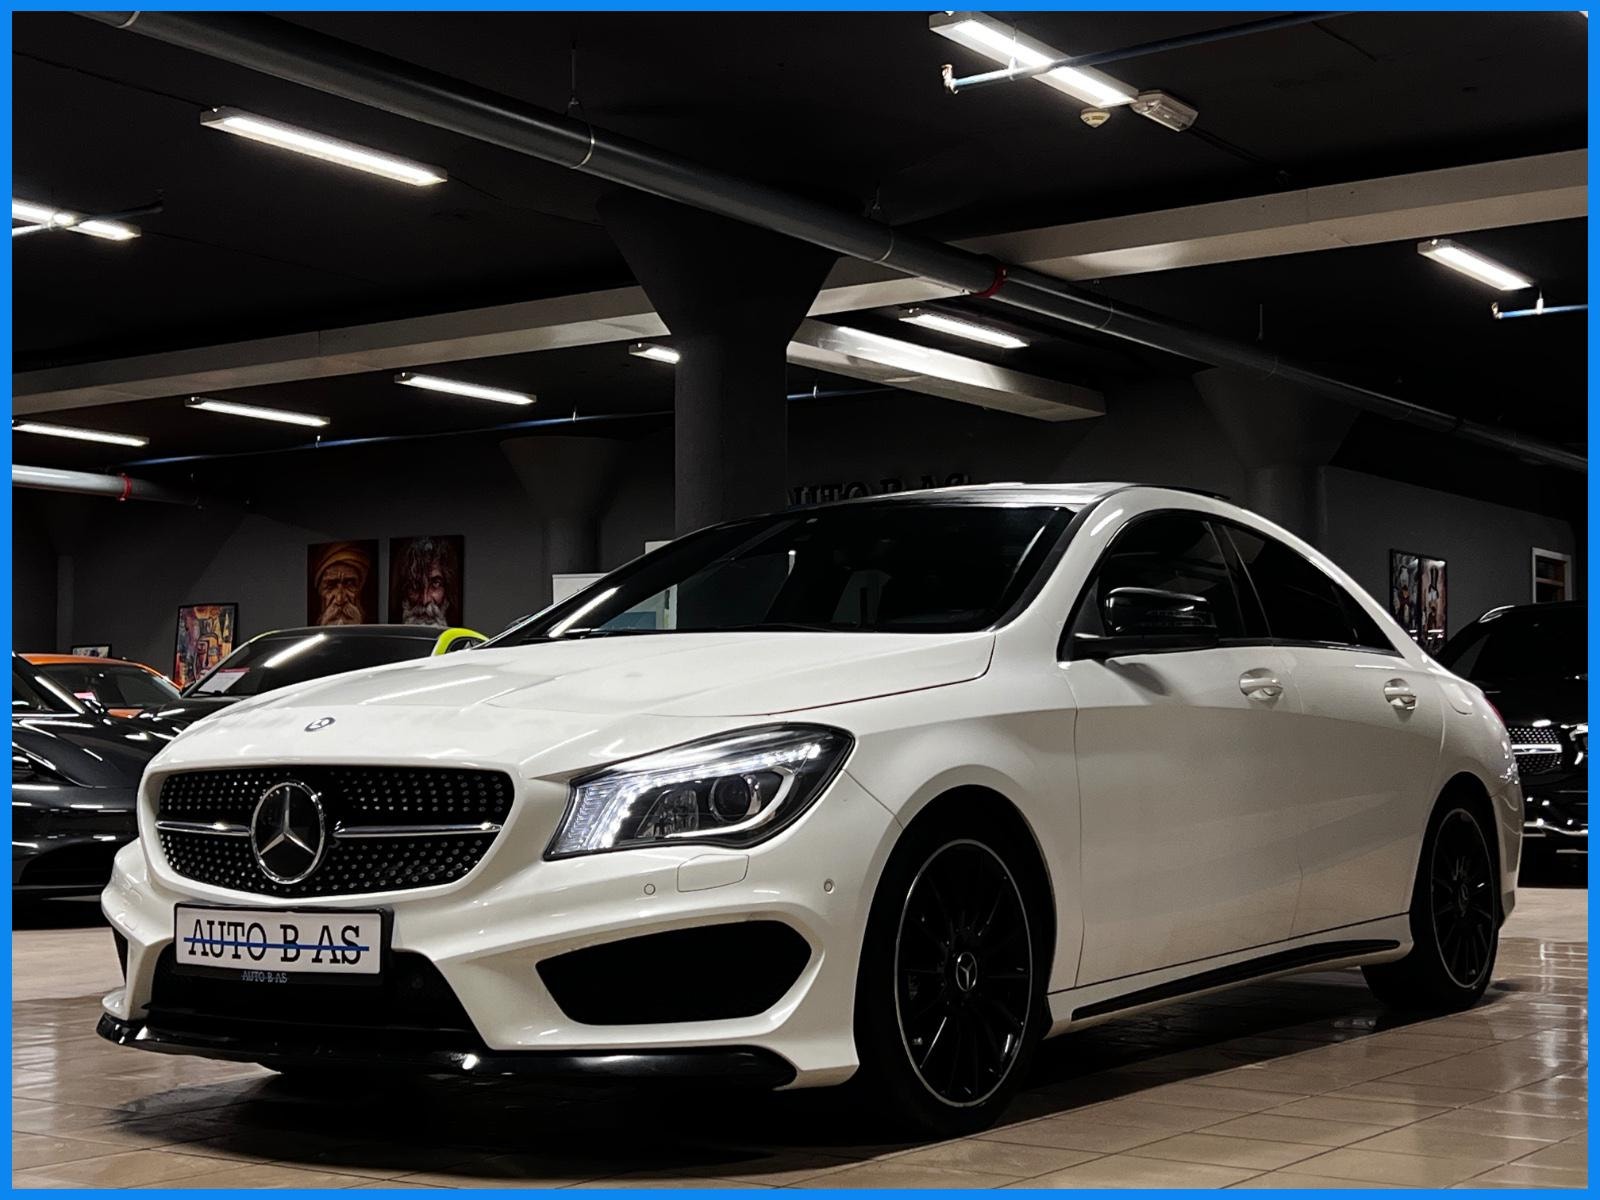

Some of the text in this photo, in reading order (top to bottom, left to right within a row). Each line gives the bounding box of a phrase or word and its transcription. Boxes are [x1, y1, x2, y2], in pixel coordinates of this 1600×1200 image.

[188, 919, 361, 965] AUTO B AS
[241, 970, 265, 982] AUTO
[275, 972, 288, 984] AS
